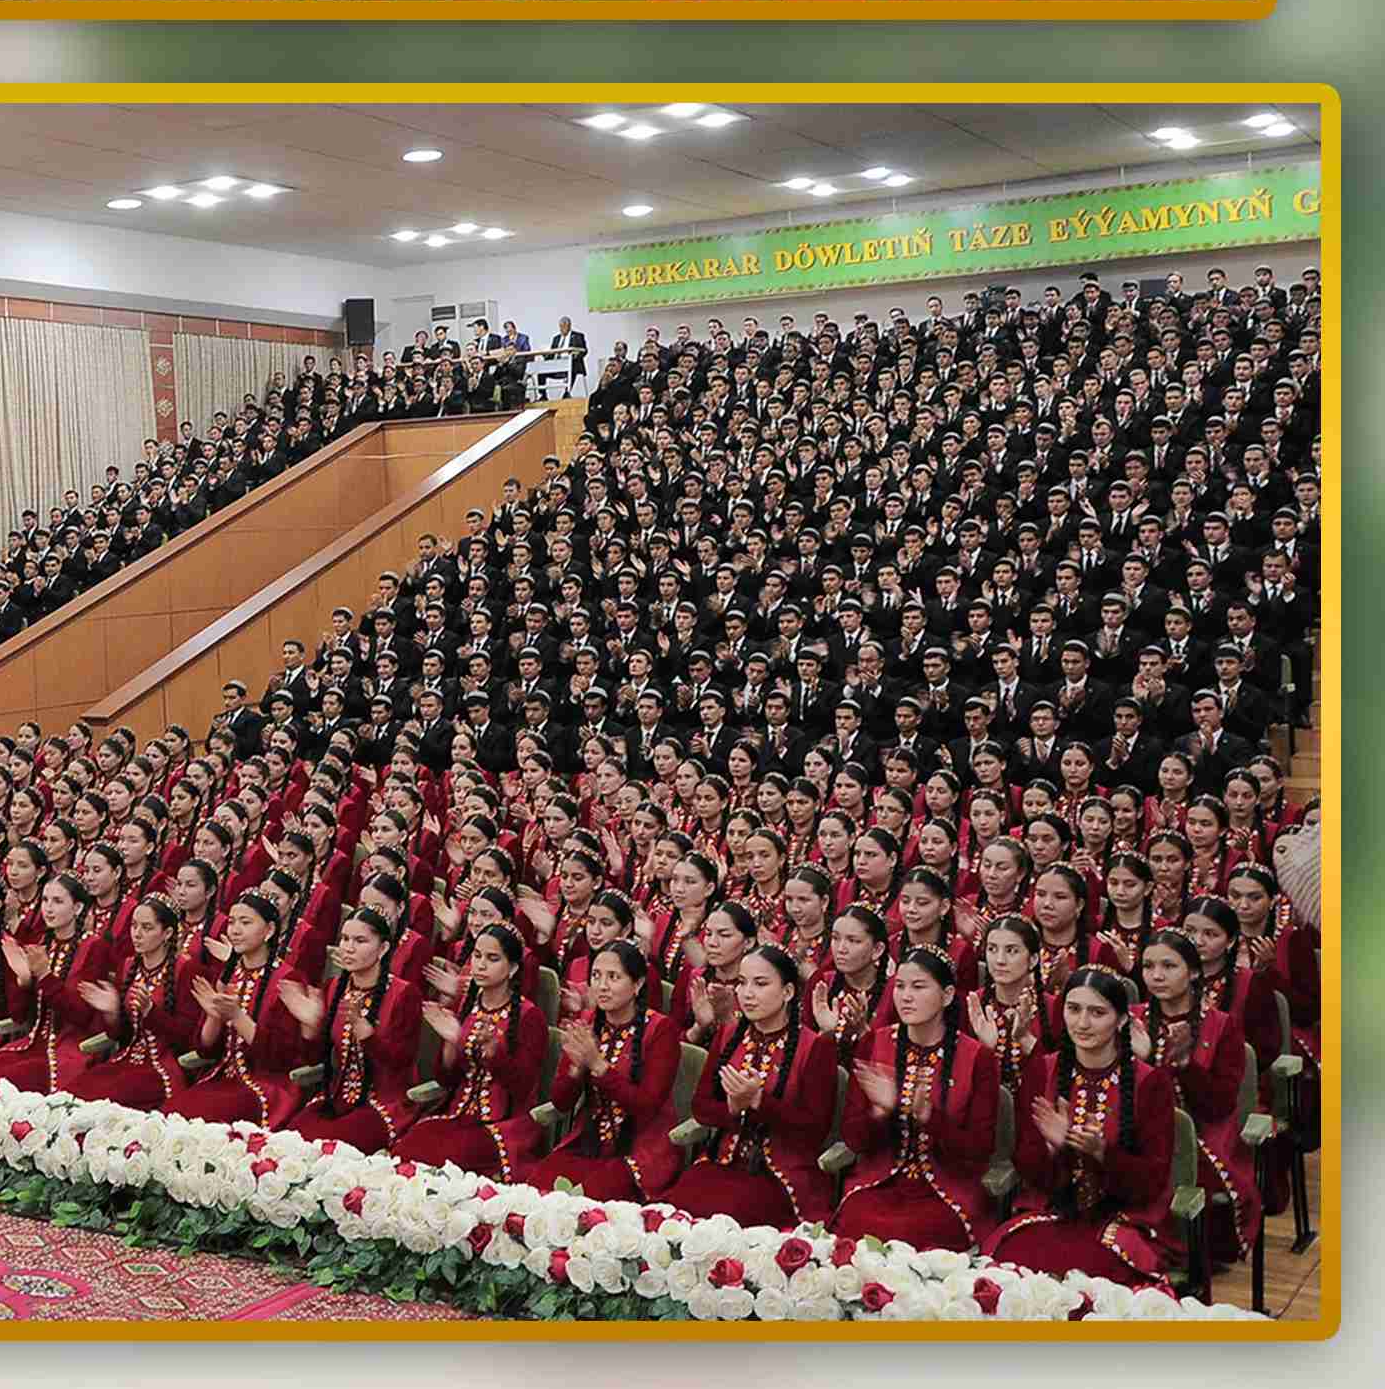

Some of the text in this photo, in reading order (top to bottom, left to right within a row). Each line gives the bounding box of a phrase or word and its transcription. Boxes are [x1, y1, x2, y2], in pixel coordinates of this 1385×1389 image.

[612, 252, 761, 290] BERKARAR
[773, 230, 933, 272] DÖWLETIŇ
[949, 223, 1033, 253] TÄZE
[1048, 188, 1274, 243] EÝÝAMYNYŇ
